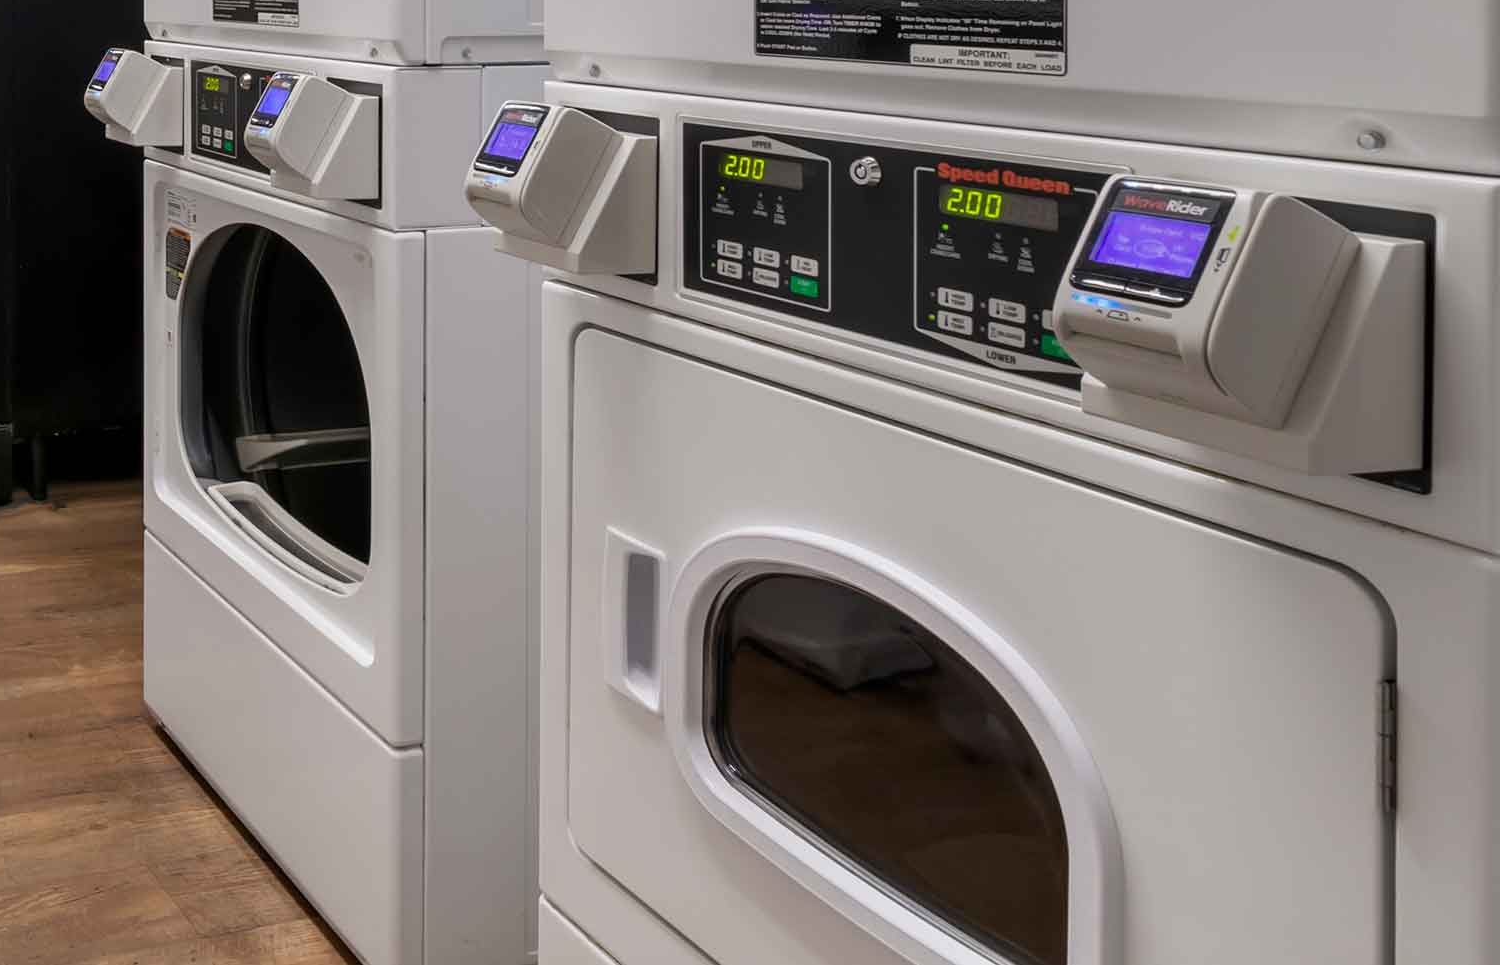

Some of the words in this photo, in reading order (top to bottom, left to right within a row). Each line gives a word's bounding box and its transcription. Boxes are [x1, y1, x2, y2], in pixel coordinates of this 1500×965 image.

[912, 56, 936, 64] CLEAN
[956, 58, 980, 67] FILTER
[983, 59, 1013, 69] BEFORE
[1016, 61, 1037, 70] EACH
[1040, 63, 1063, 72] LOAD
[724, 155, 765, 180] 2.00
[937, 162, 1000, 185] Speed
[1001, 170, 1072, 195] Queen
[947, 187, 1003, 219] 2.00
[1123, 194, 1210, 217] WaveRider
[985, 349, 1017, 365] LOWER
